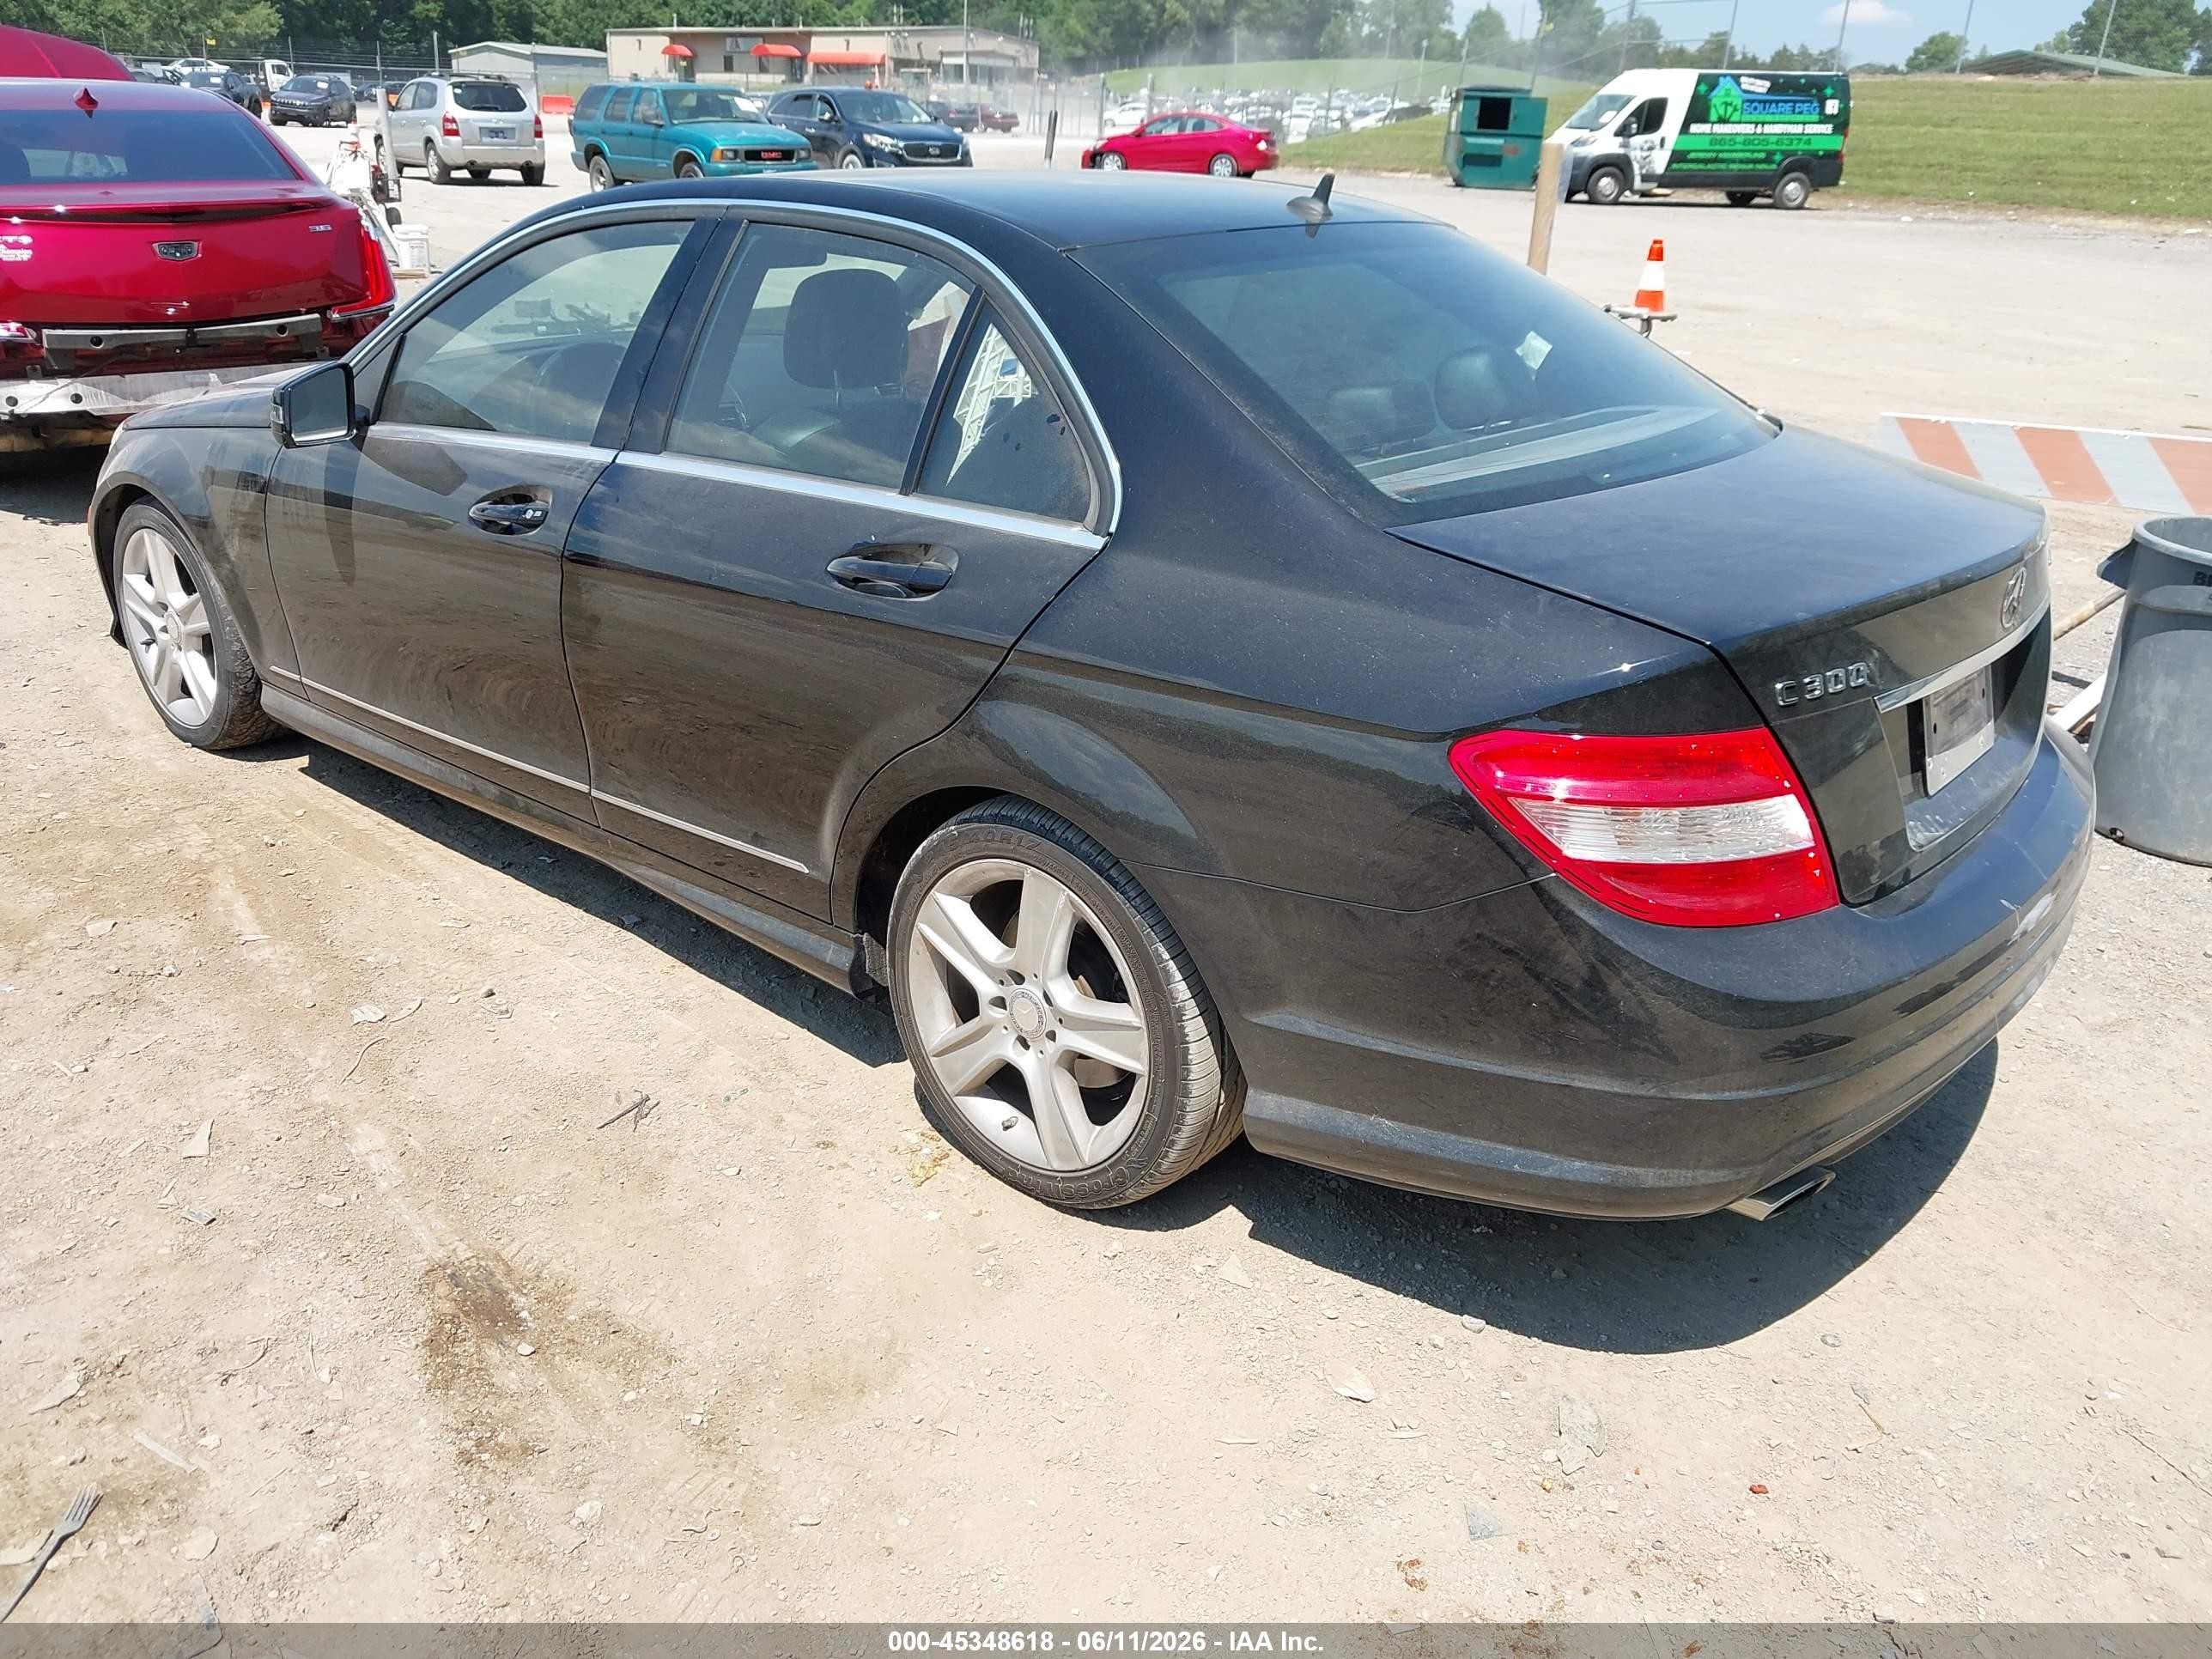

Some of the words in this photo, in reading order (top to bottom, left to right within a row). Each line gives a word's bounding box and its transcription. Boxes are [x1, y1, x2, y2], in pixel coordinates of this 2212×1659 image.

[1743, 102, 1794, 114] SQUARE
[1795, 103, 1820, 114] PEG
[1709, 137, 1812, 147] 865-805-6374
[761, 150, 783, 160] GMC
